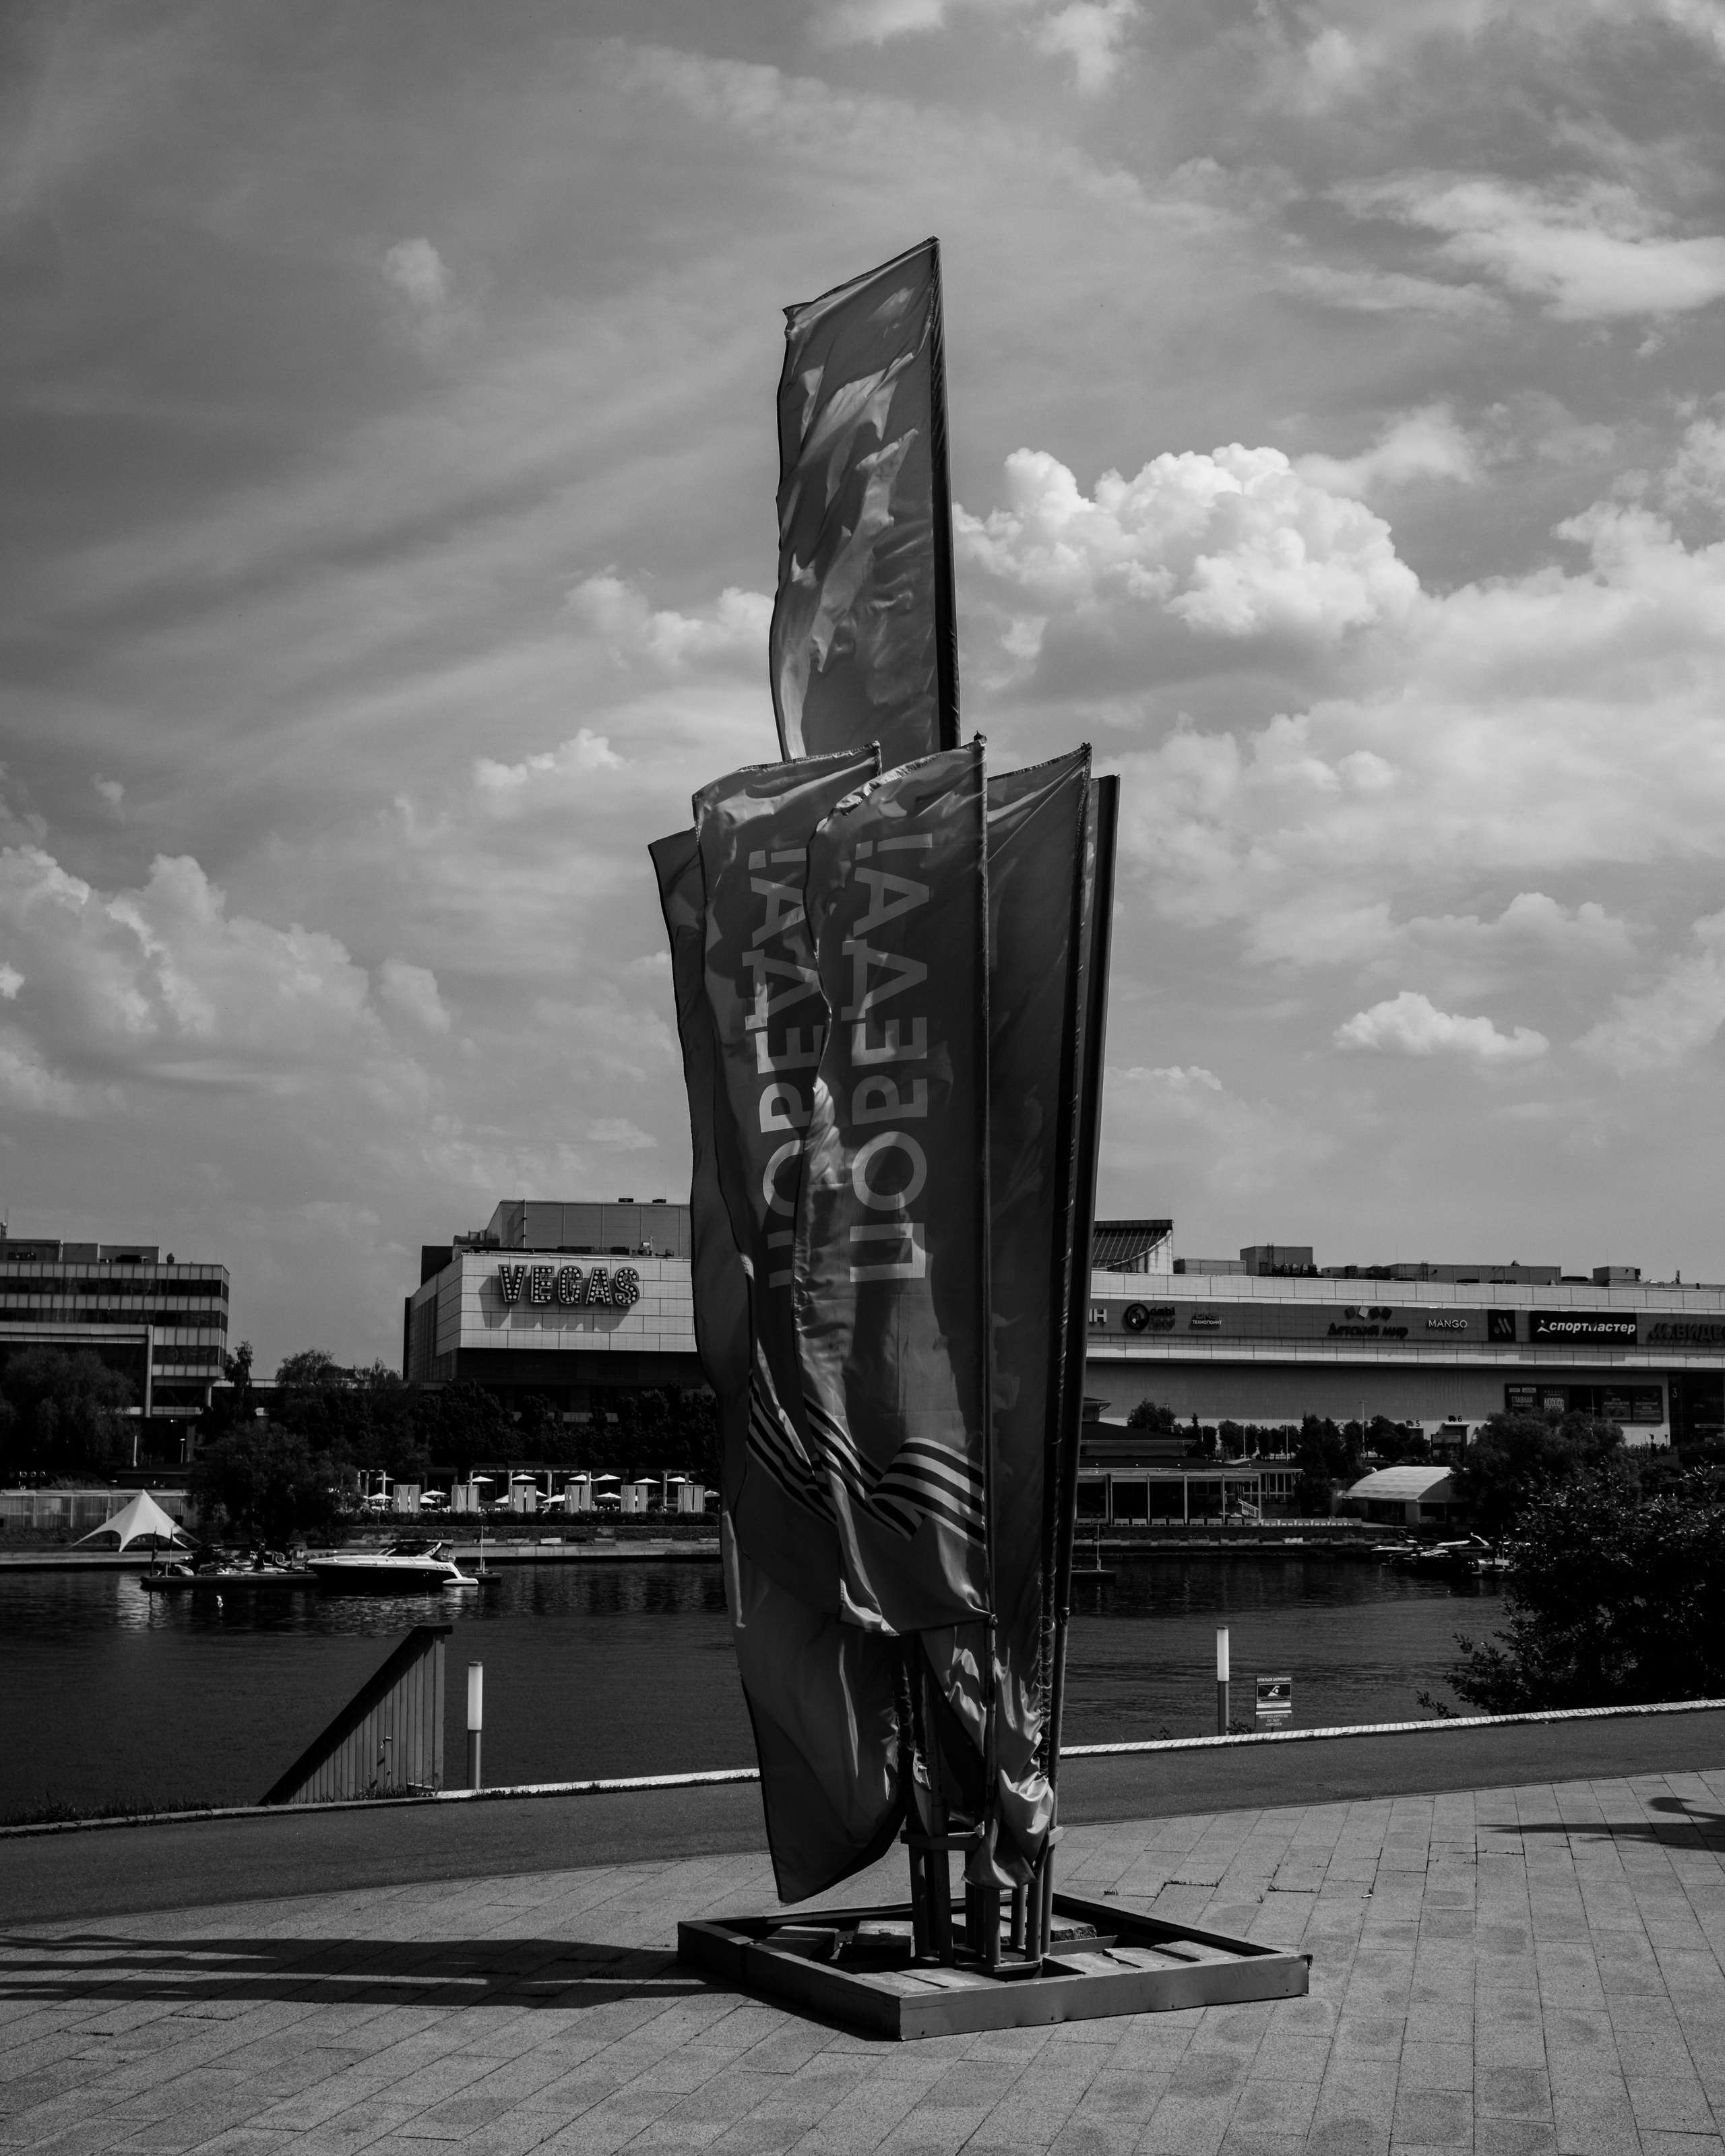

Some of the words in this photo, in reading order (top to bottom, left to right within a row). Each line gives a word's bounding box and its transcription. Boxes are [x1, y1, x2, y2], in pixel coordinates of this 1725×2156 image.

[497, 1264, 640, 1306] VEGAS
[1195, 1312, 1220, 1320] DNS
[1428, 1319, 1468, 1329] MANGO
[1327, 1322, 1379, 1337] Детский
[1381, 1326, 1409, 1339] мир
[1672, 1387, 1678, 1398] 3
